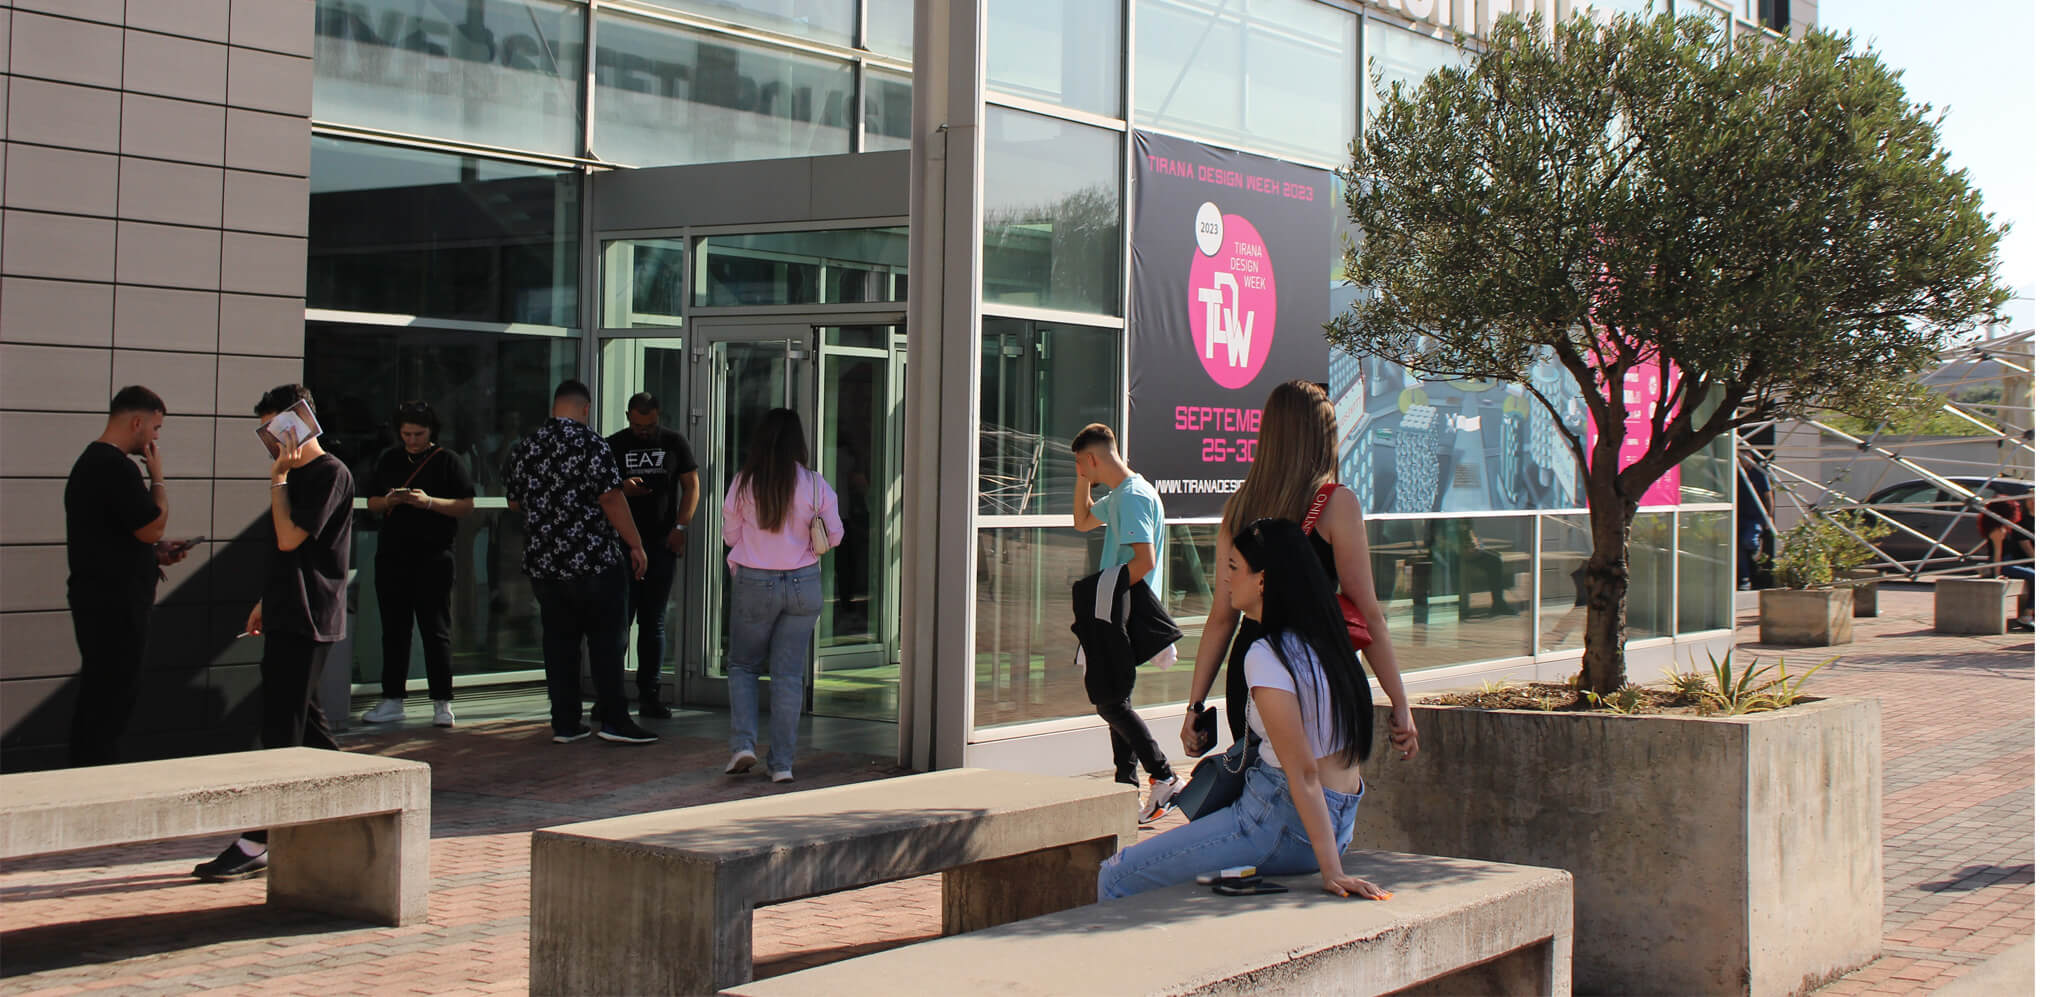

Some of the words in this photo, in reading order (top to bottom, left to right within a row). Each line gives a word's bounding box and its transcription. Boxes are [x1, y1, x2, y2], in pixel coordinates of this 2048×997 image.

[1148, 154, 1194, 179] TIRANA
[1198, 165, 1243, 188] DESIGN
[1283, 181, 1314, 201] 2023
[1200, 221, 1219, 235] 2023
[1234, 241, 1263, 258] TIRANA
[1230, 257, 1259, 273] DESIGN
[1243, 275, 1266, 290] WEEK
[1175, 405, 1264, 432] SEPTEMB
[625, 451, 666, 468] EA7
[1155, 479, 1246, 494] WWW.TIRANADESI
